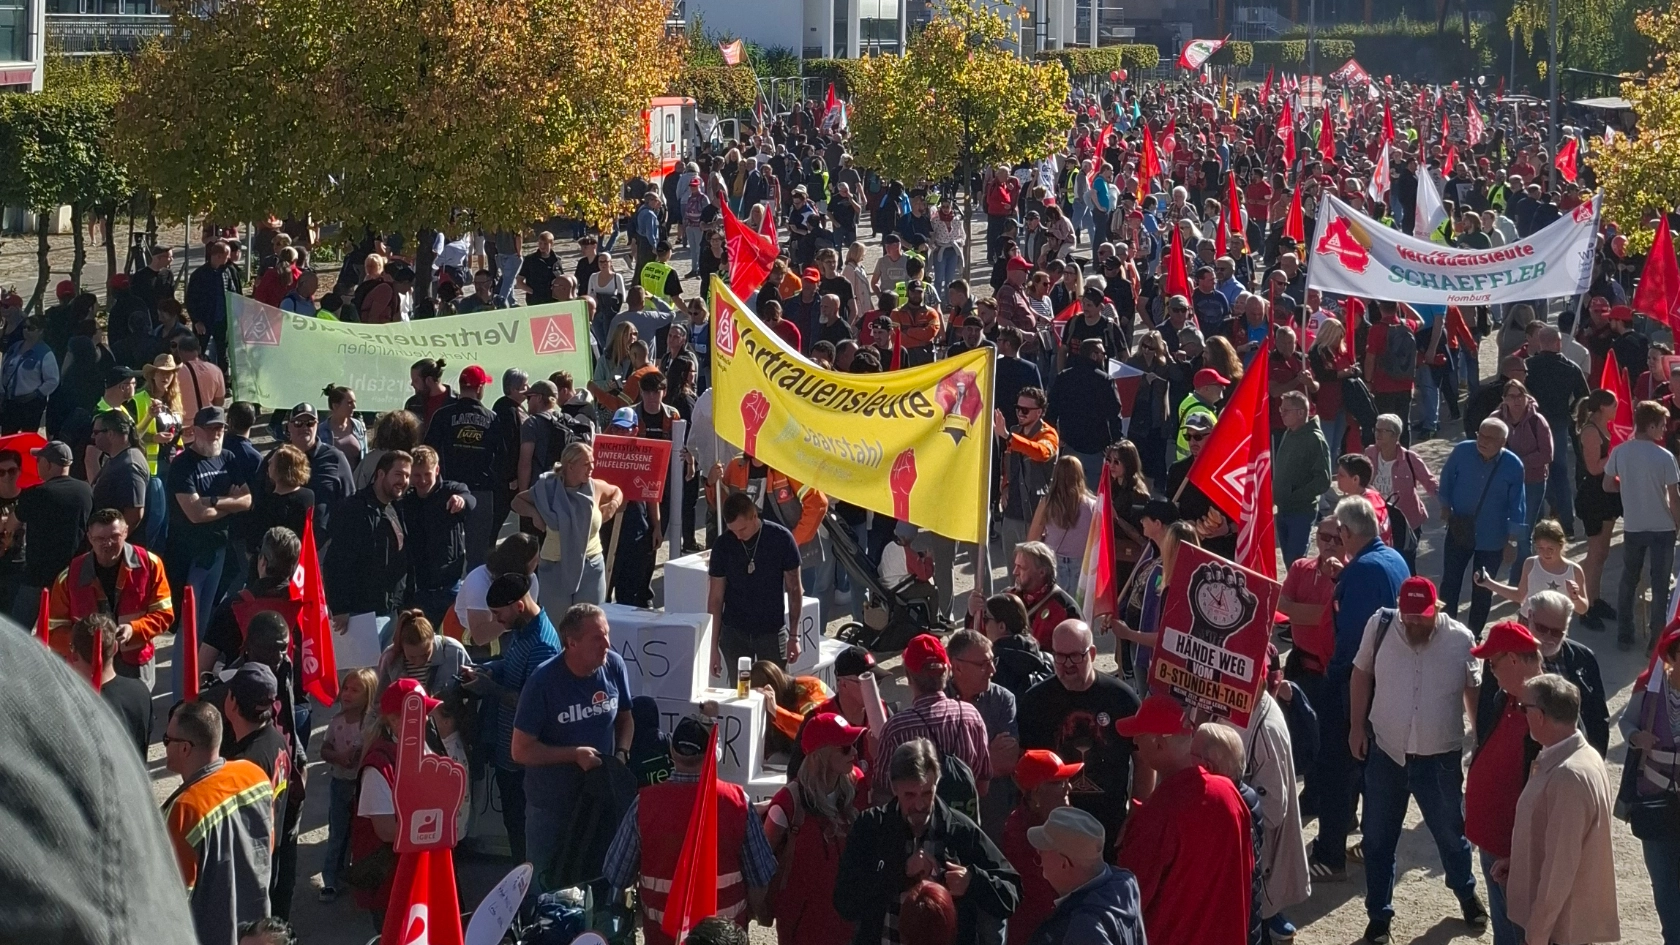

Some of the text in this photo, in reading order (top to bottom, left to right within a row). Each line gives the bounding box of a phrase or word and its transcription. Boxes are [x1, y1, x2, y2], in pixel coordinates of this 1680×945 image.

[1388, 261, 1546, 292] SCHAEFFLER
[1446, 293, 1491, 303] Homburg
[598, 451, 653, 462] UNTERLASSENE
[599, 442, 653, 453] NICHTSTUN IST
[596, 460, 652, 471] HILFELEISTUNG.
[1175, 634, 1215, 666] HÄNDE
[1219, 650, 1246, 677] WEG
[1192, 662, 1214, 680] VOM
[1159, 662, 1249, 710] 8-STUNDEN-TAG!
[557, 697, 618, 724] ellesse
